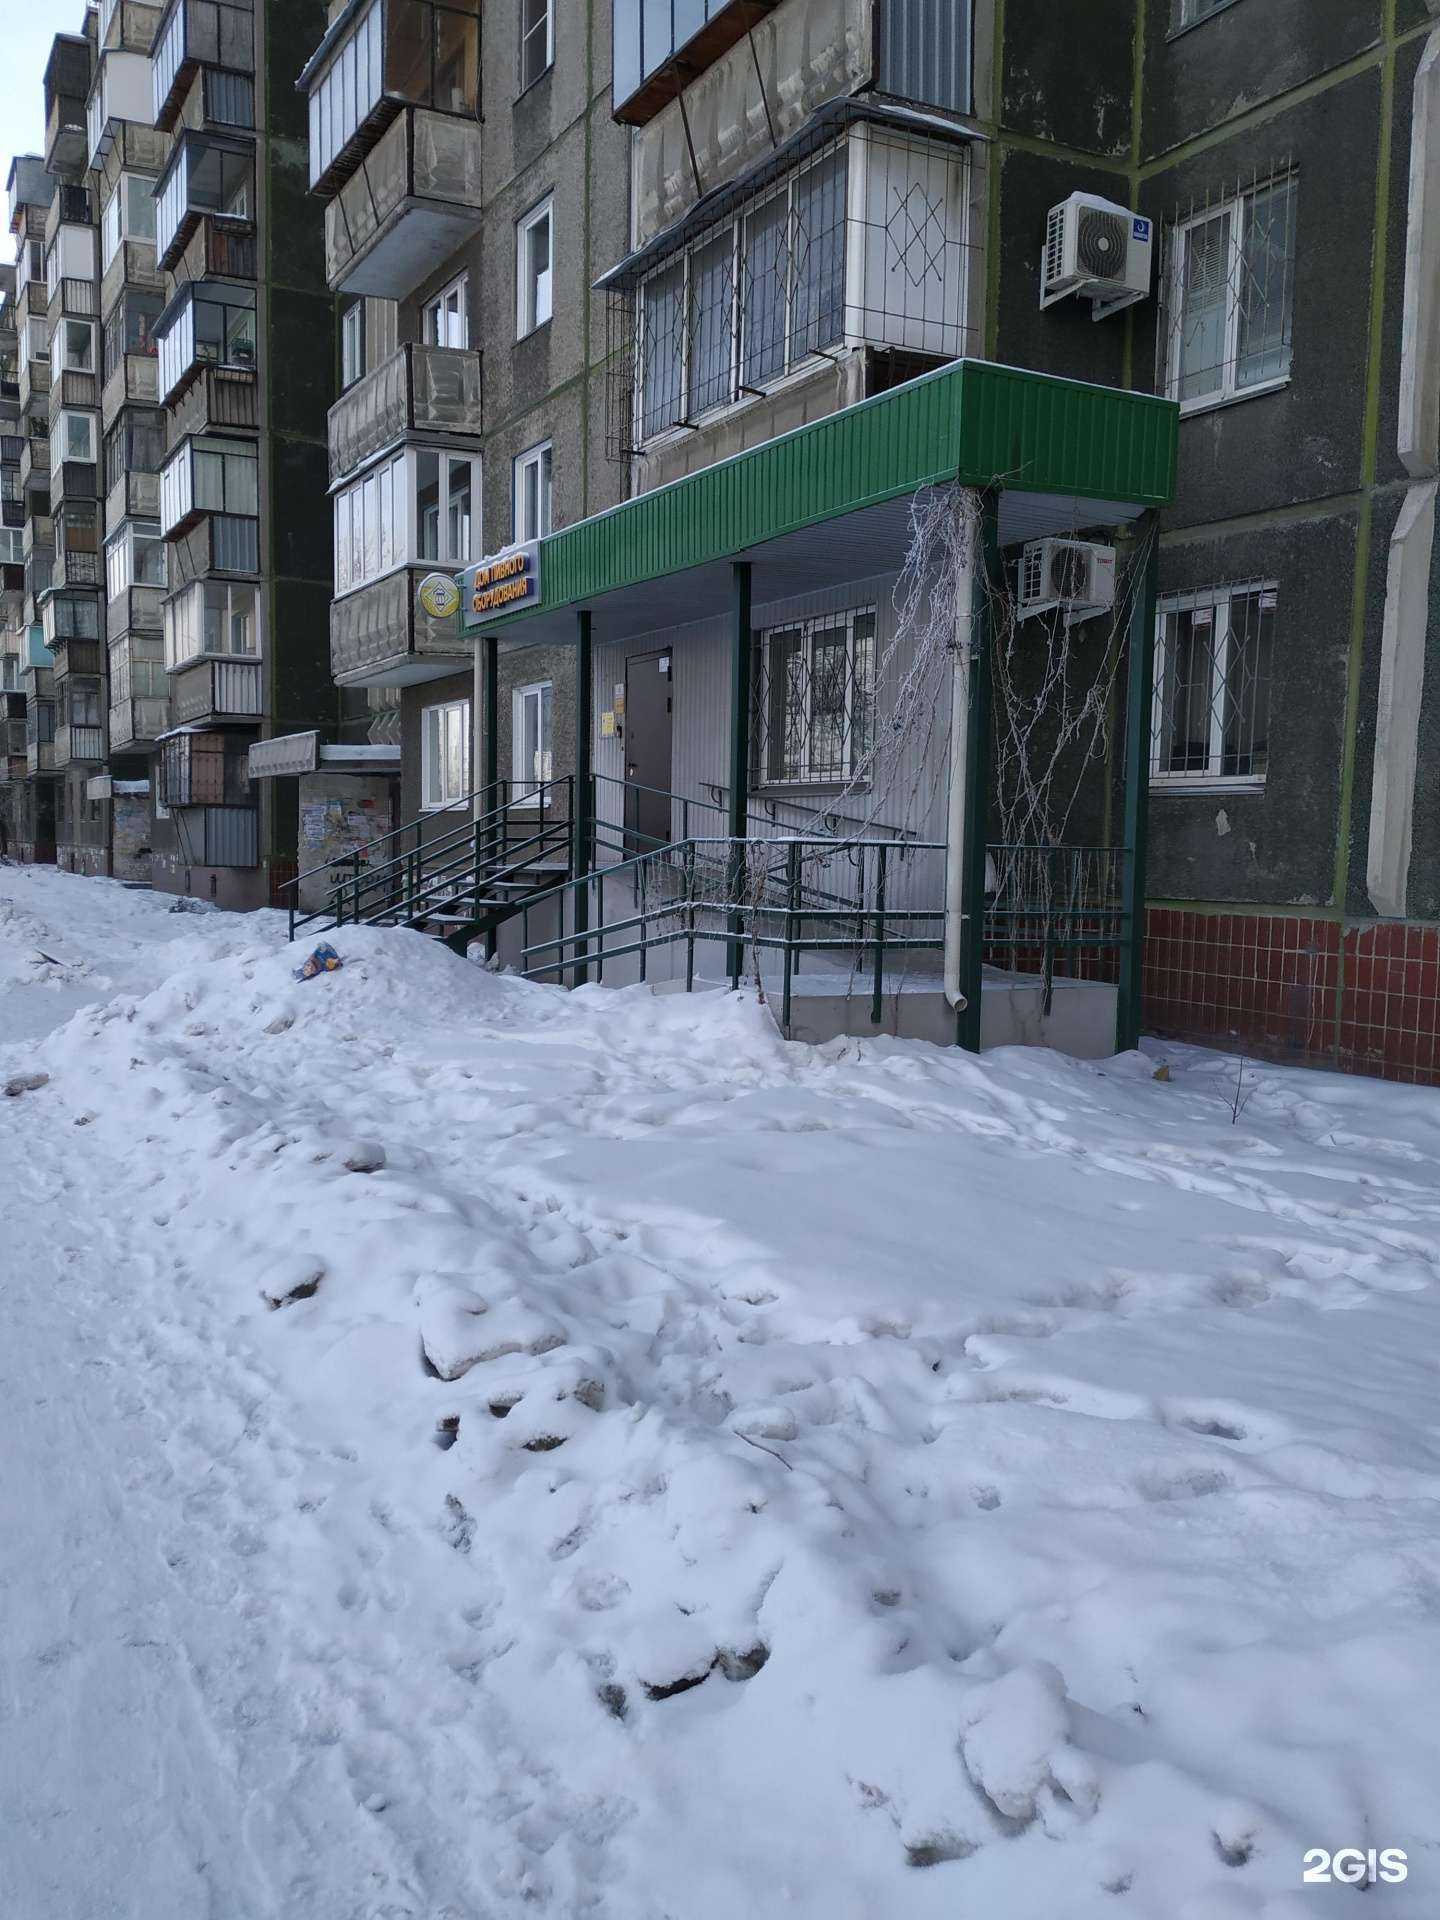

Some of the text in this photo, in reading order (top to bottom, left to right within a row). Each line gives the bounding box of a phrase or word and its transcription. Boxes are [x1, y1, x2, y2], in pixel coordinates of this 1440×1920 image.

[473, 555, 524, 590] ДОМ ПИВНОГО
[473, 579, 527, 612] ОБОРУДОВАНИЯ
